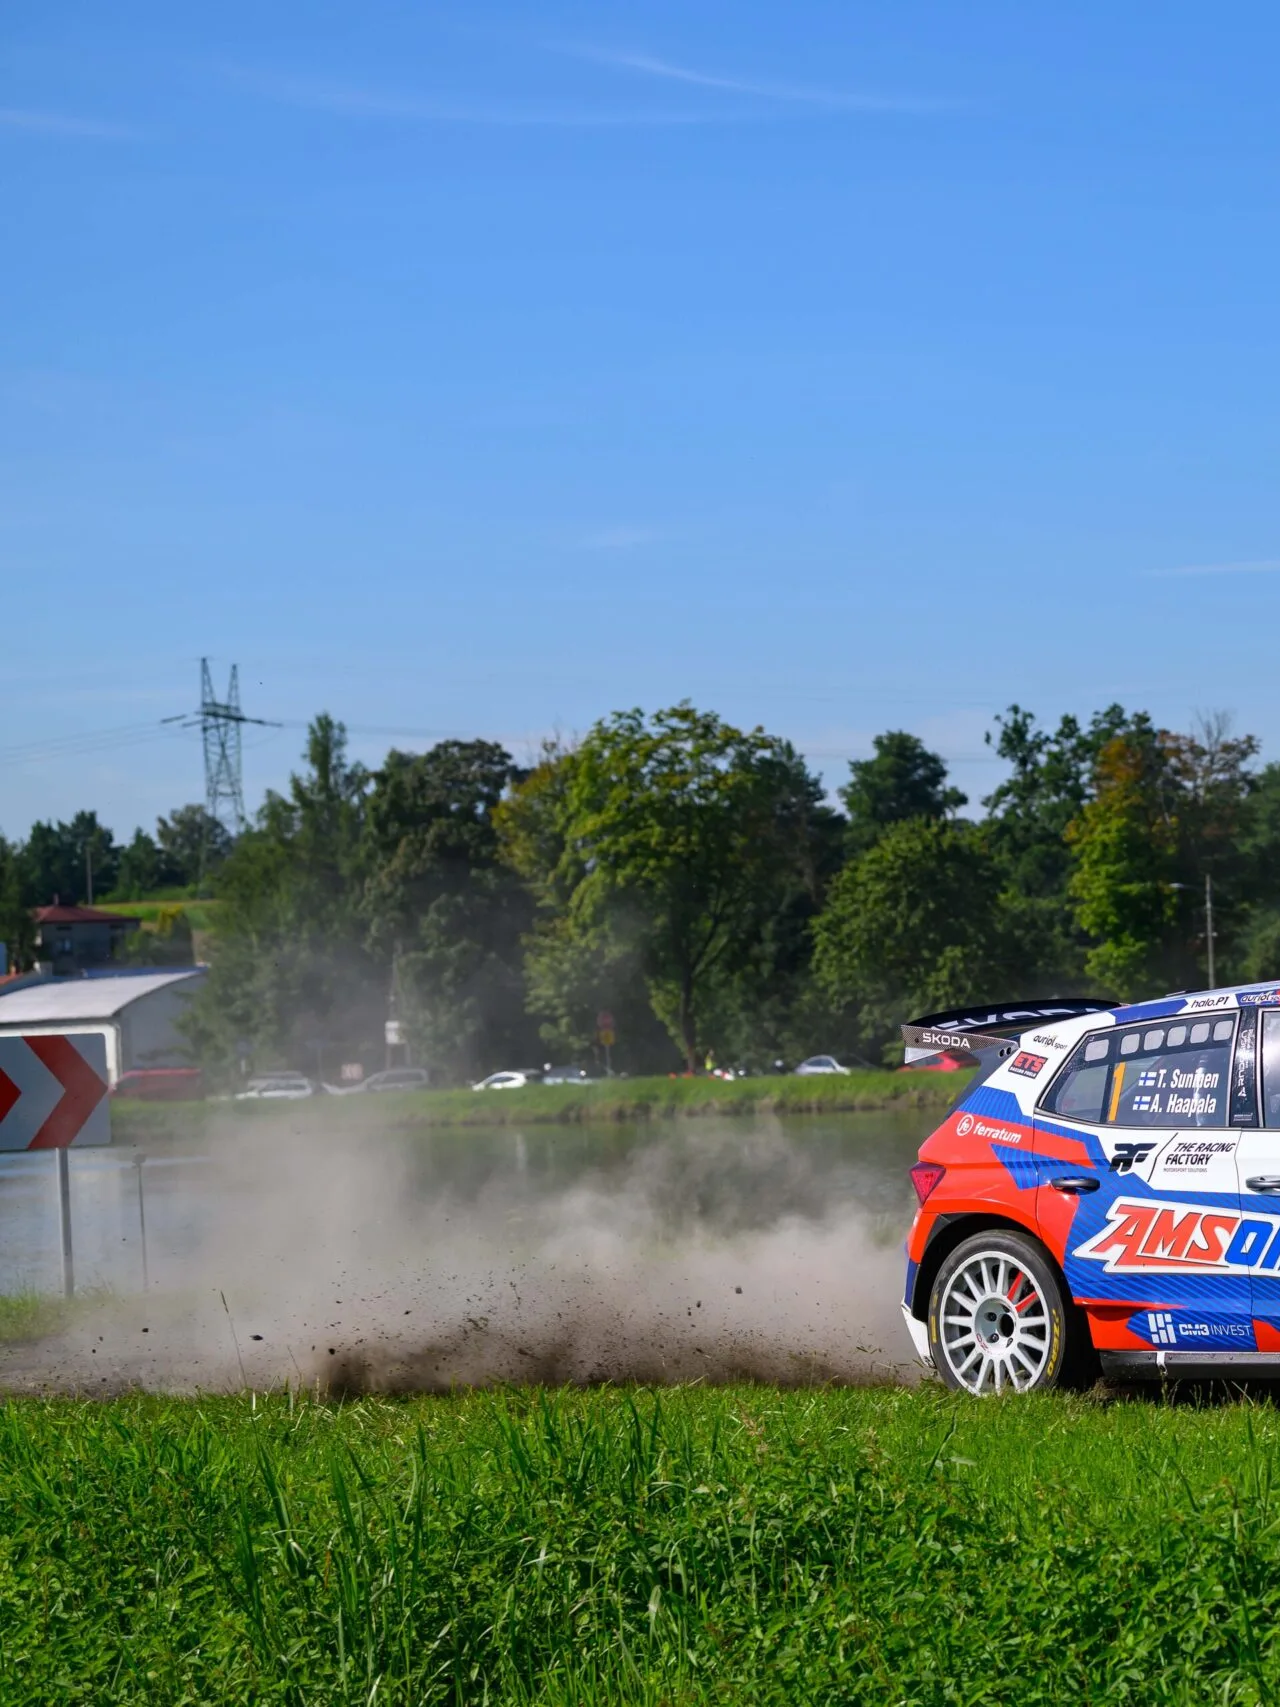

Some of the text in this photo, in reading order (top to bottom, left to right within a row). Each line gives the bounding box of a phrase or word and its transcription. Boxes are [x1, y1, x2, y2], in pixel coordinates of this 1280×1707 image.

[1013, 1052, 1047, 1073] ETS
[1157, 1068, 1168, 1089] T.
[1107, 1061, 1126, 1123] 1
[1149, 1093, 1217, 1118] A. Haapala
[972, 1121, 1022, 1144] ferratum
[1174, 1142, 1236, 1153] THE RACING
[1165, 1153, 1213, 1165] FACTORY
[1210, 1324, 1251, 1338] INVEST
